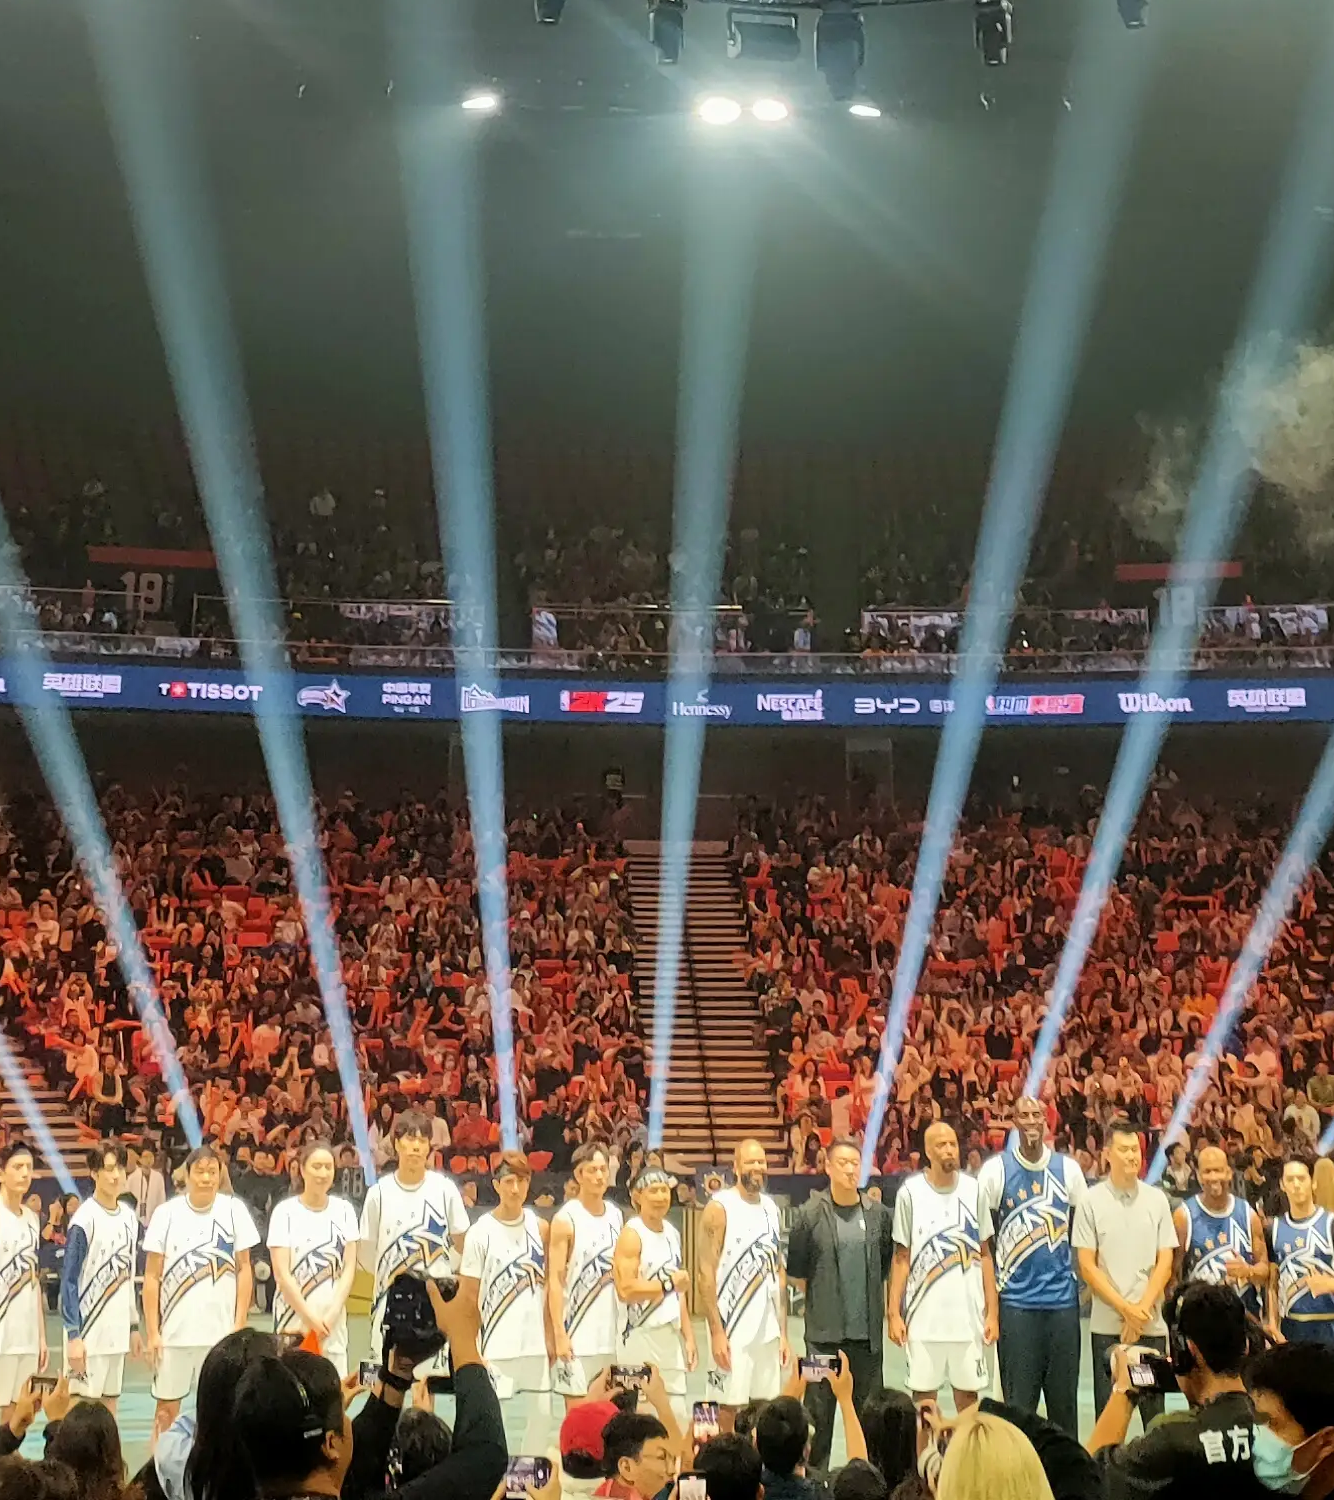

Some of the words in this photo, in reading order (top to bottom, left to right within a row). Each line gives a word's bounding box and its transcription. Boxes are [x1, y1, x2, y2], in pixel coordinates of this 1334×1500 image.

[187, 682, 263, 701] TISSOT
[672, 701, 733, 719] Hennessy
[854, 697, 920, 714] BYD
[1118, 692, 1194, 713] Wilson
